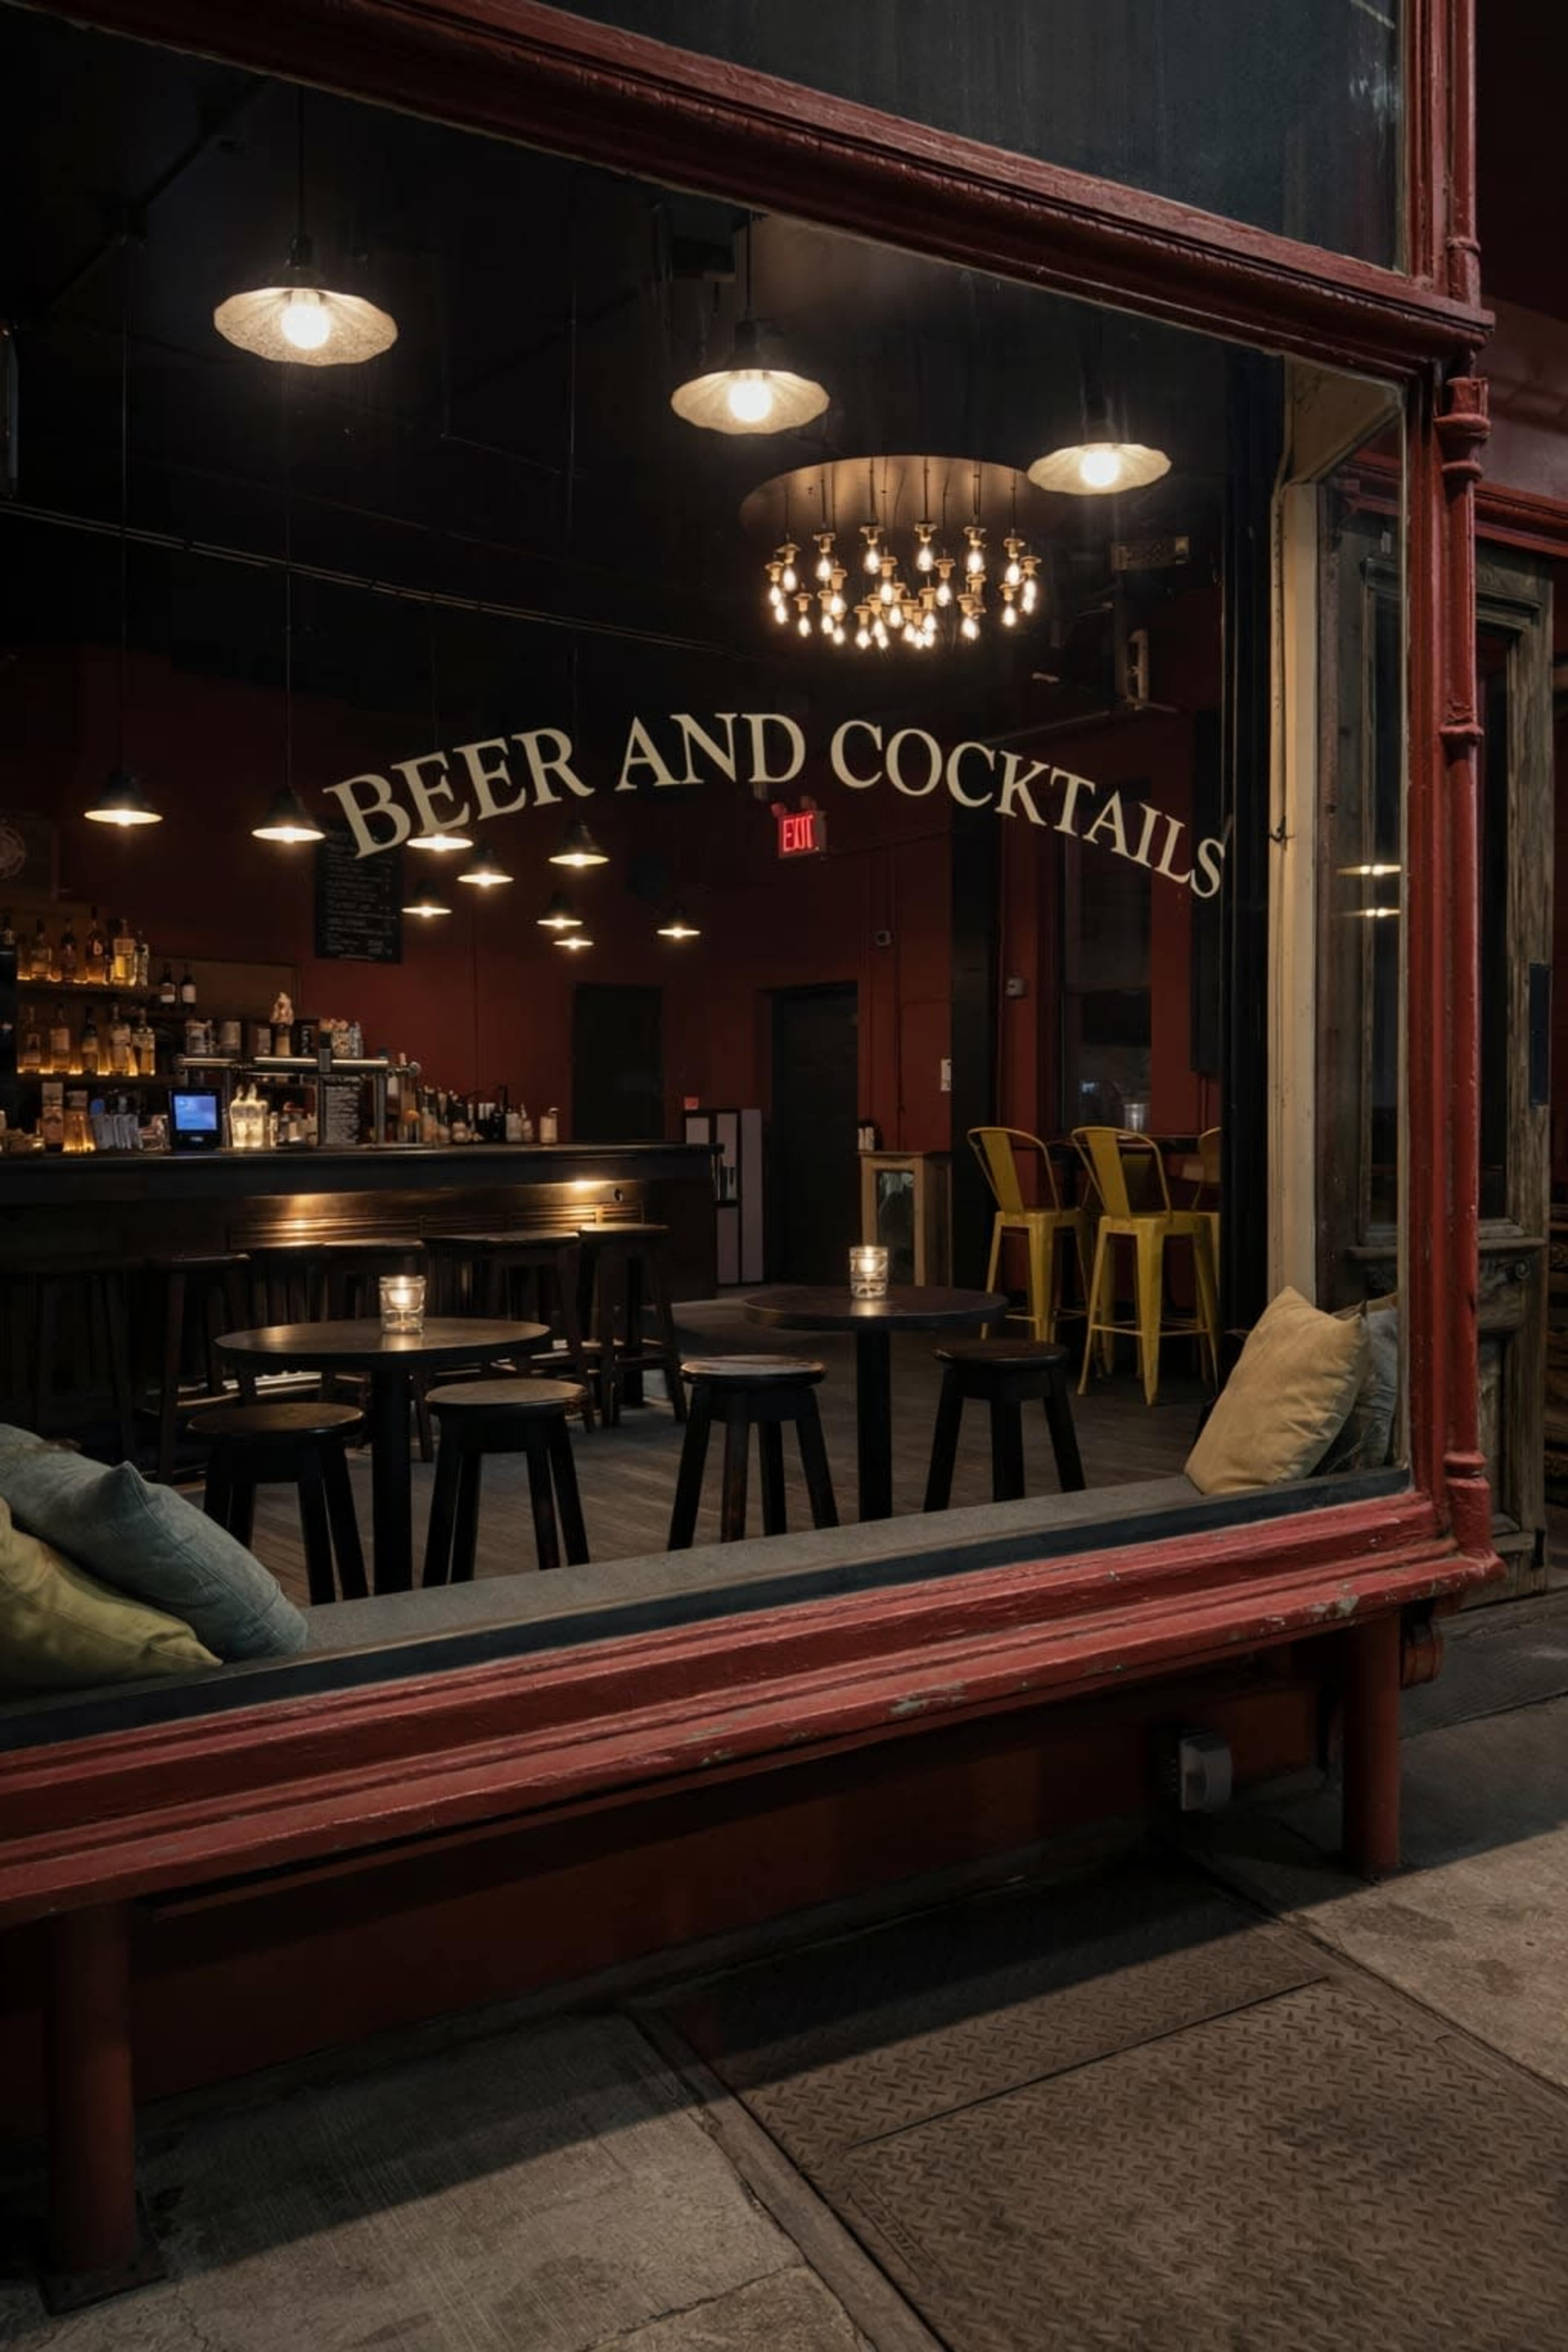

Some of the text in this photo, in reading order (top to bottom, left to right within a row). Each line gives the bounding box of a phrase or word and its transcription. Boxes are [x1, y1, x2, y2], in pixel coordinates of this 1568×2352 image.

[323, 713, 1225, 898] BEER AND COCKTAILS
[783, 815, 814, 852] EXIT
